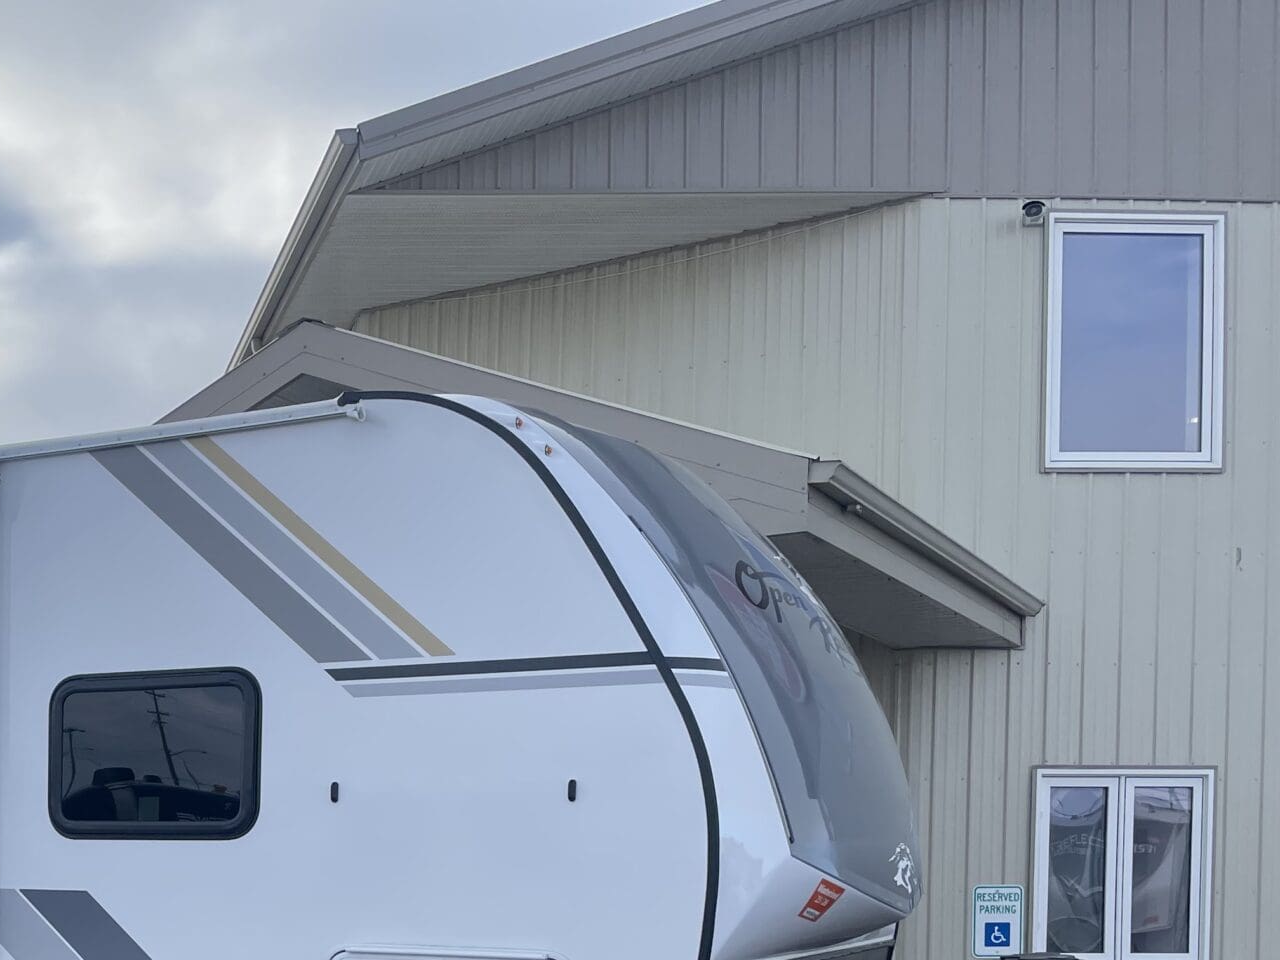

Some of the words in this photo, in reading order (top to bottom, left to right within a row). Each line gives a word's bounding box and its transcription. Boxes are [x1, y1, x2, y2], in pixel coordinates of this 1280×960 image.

[735, 561, 808, 623] Open
[976, 893, 1020, 902] RESERVED
[980, 905, 1017, 914] PARKING
